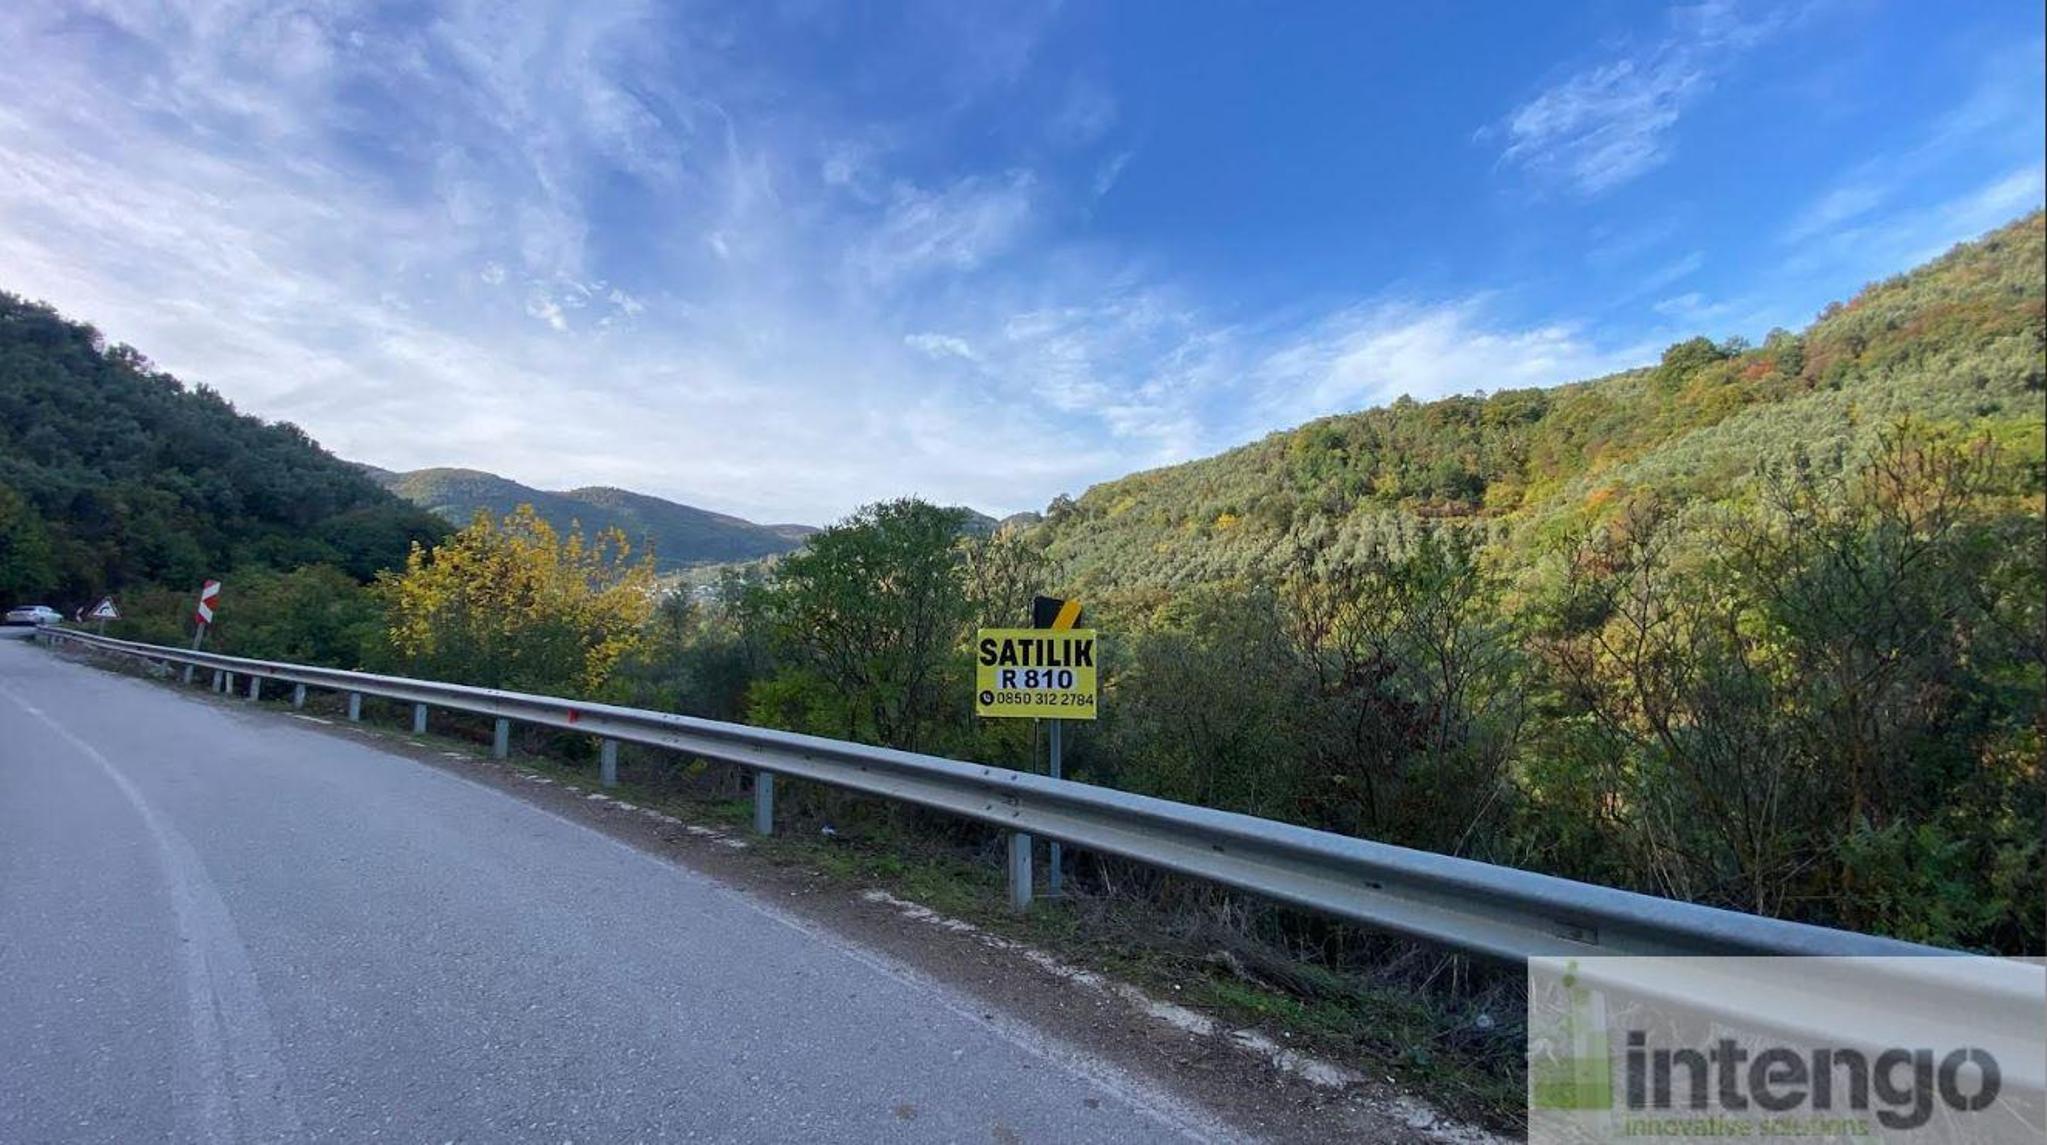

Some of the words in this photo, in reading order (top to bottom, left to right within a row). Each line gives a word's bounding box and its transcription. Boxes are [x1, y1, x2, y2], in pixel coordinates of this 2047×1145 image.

[980, 638, 1093, 667] SATILIK
[1002, 669, 1017, 689] R
[1024, 669, 1073, 689] 810
[997, 692, 1031, 705] 0850
[1035, 693, 1057, 706] 312
[1061, 694, 1093, 707] 2784
